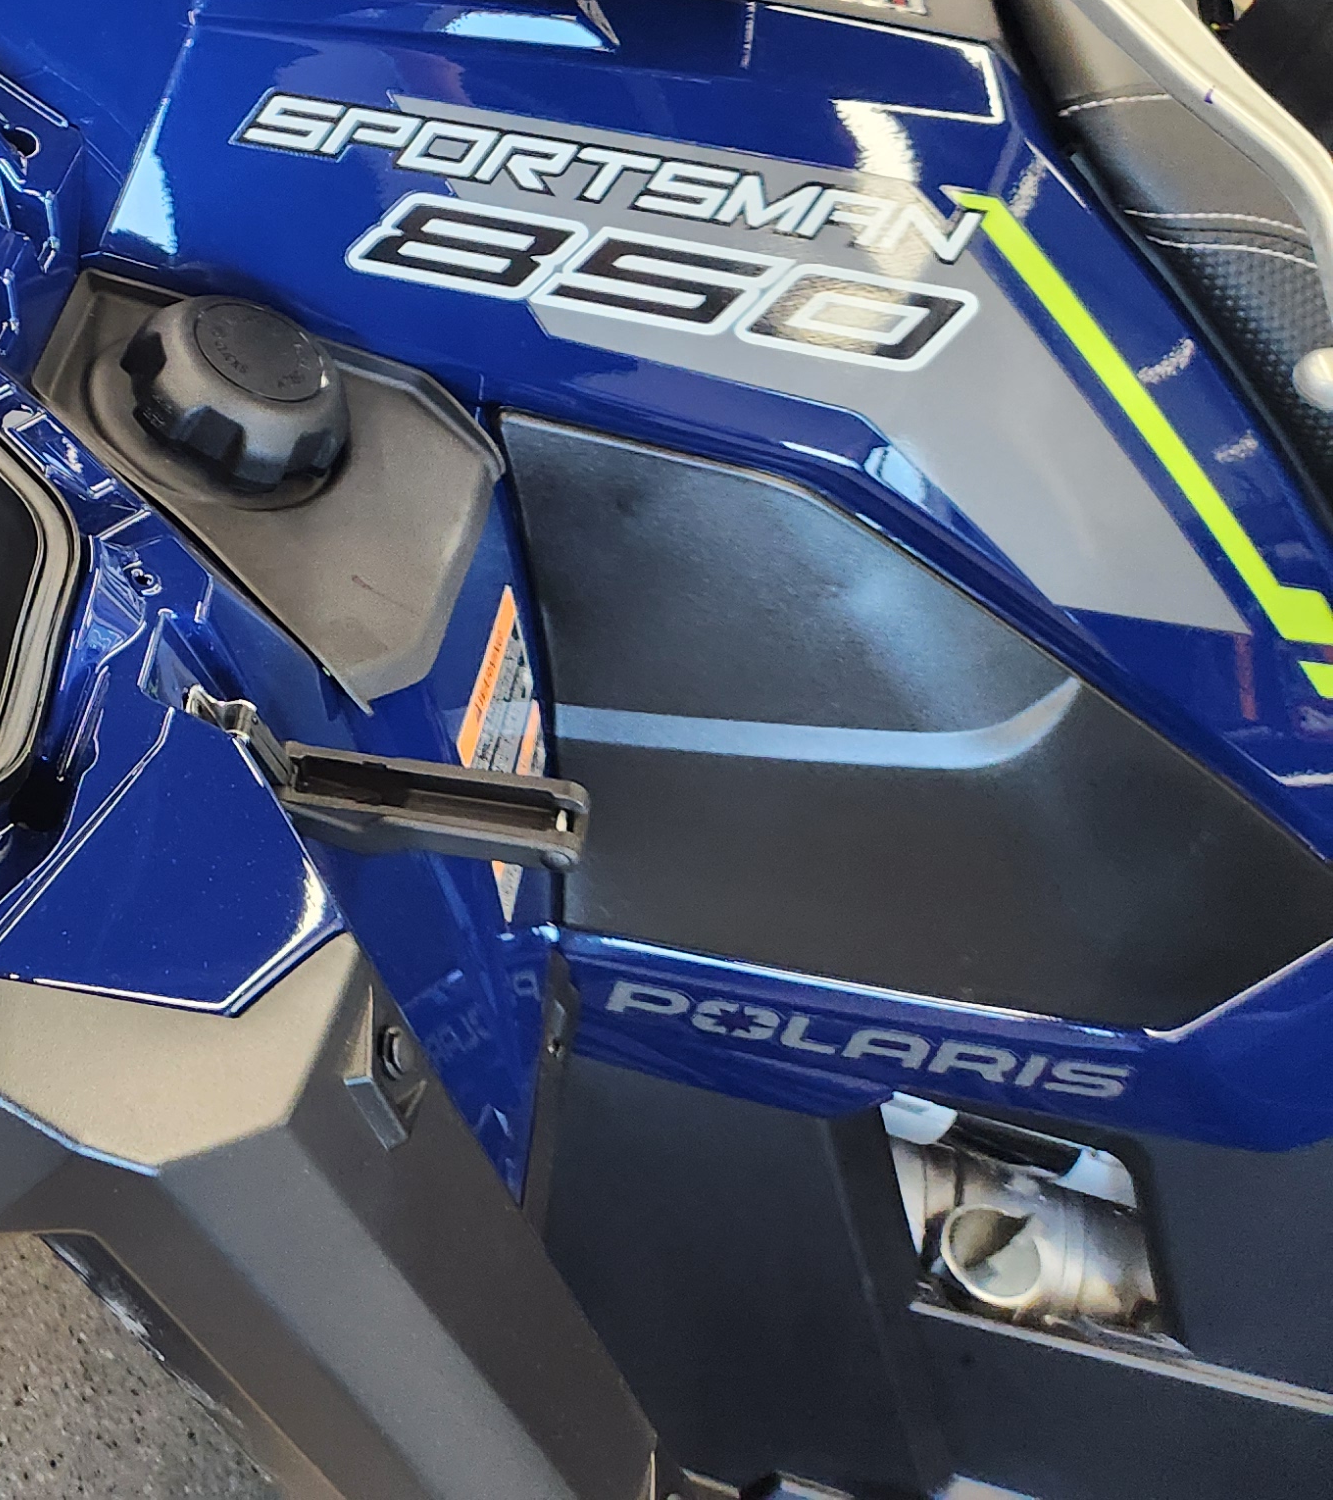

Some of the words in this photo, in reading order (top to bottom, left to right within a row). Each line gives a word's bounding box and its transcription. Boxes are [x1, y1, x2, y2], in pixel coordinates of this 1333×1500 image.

[235, 90, 984, 265] SPORTSMAN
[344, 190, 978, 372] 850
[605, 980, 1130, 1098] POLARIS
